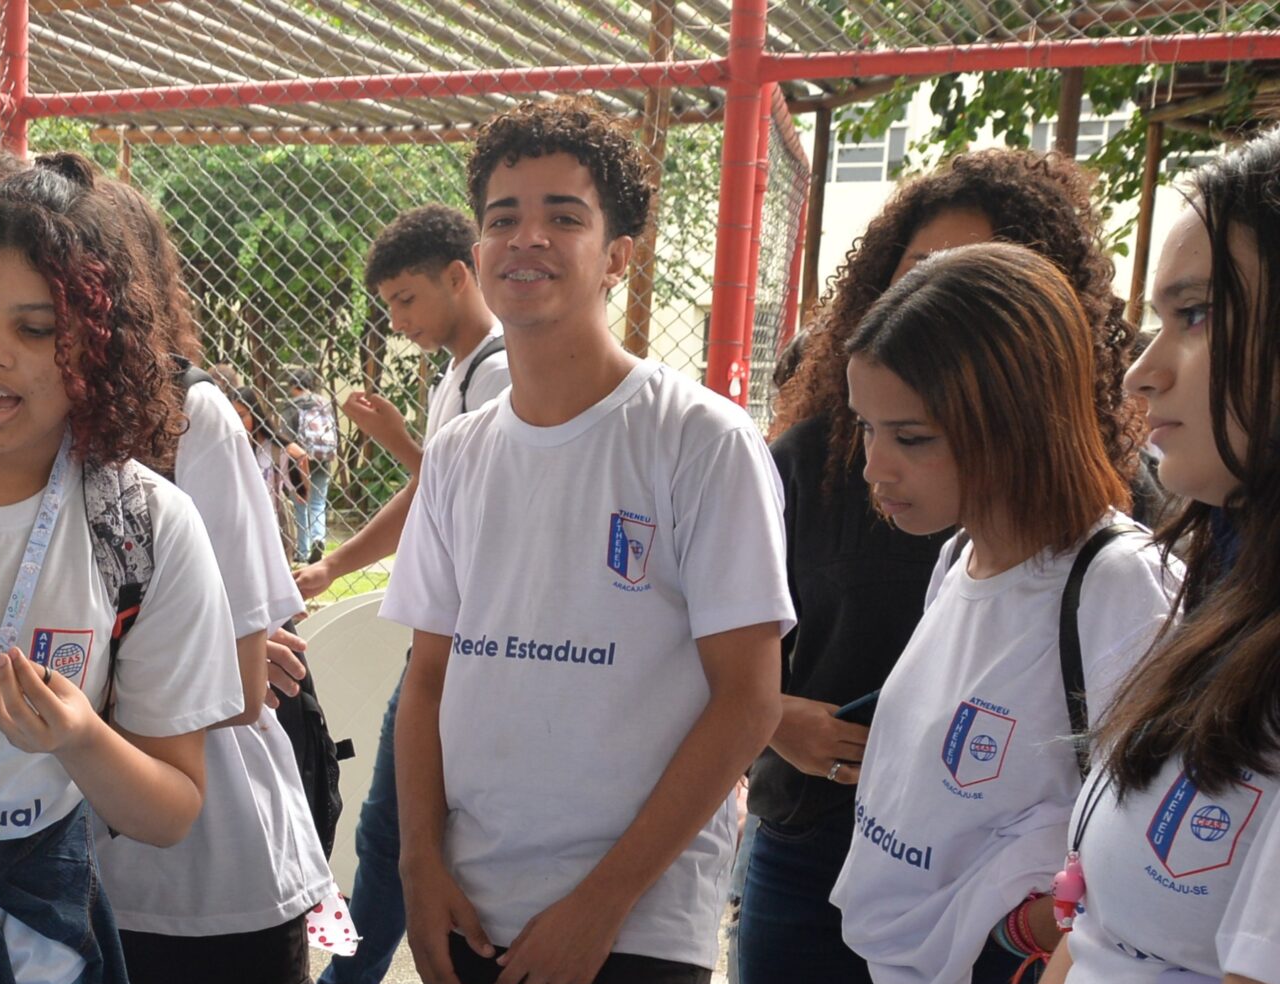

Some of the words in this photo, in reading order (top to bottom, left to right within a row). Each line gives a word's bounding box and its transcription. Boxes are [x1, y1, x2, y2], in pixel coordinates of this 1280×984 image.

[619, 509, 651, 523] THENEU
[36, 632, 48, 664] ATH
[54, 653, 81, 668] CEAS
[453, 632, 499, 657] Rede
[505, 636, 616, 666] Estadual
[969, 697, 1010, 716] ATHENEU
[946, 708, 969, 765] ATHENEU
[1153, 778, 1190, 845] THENEU
[1144, 865, 1209, 896] ARACAJU-SE
